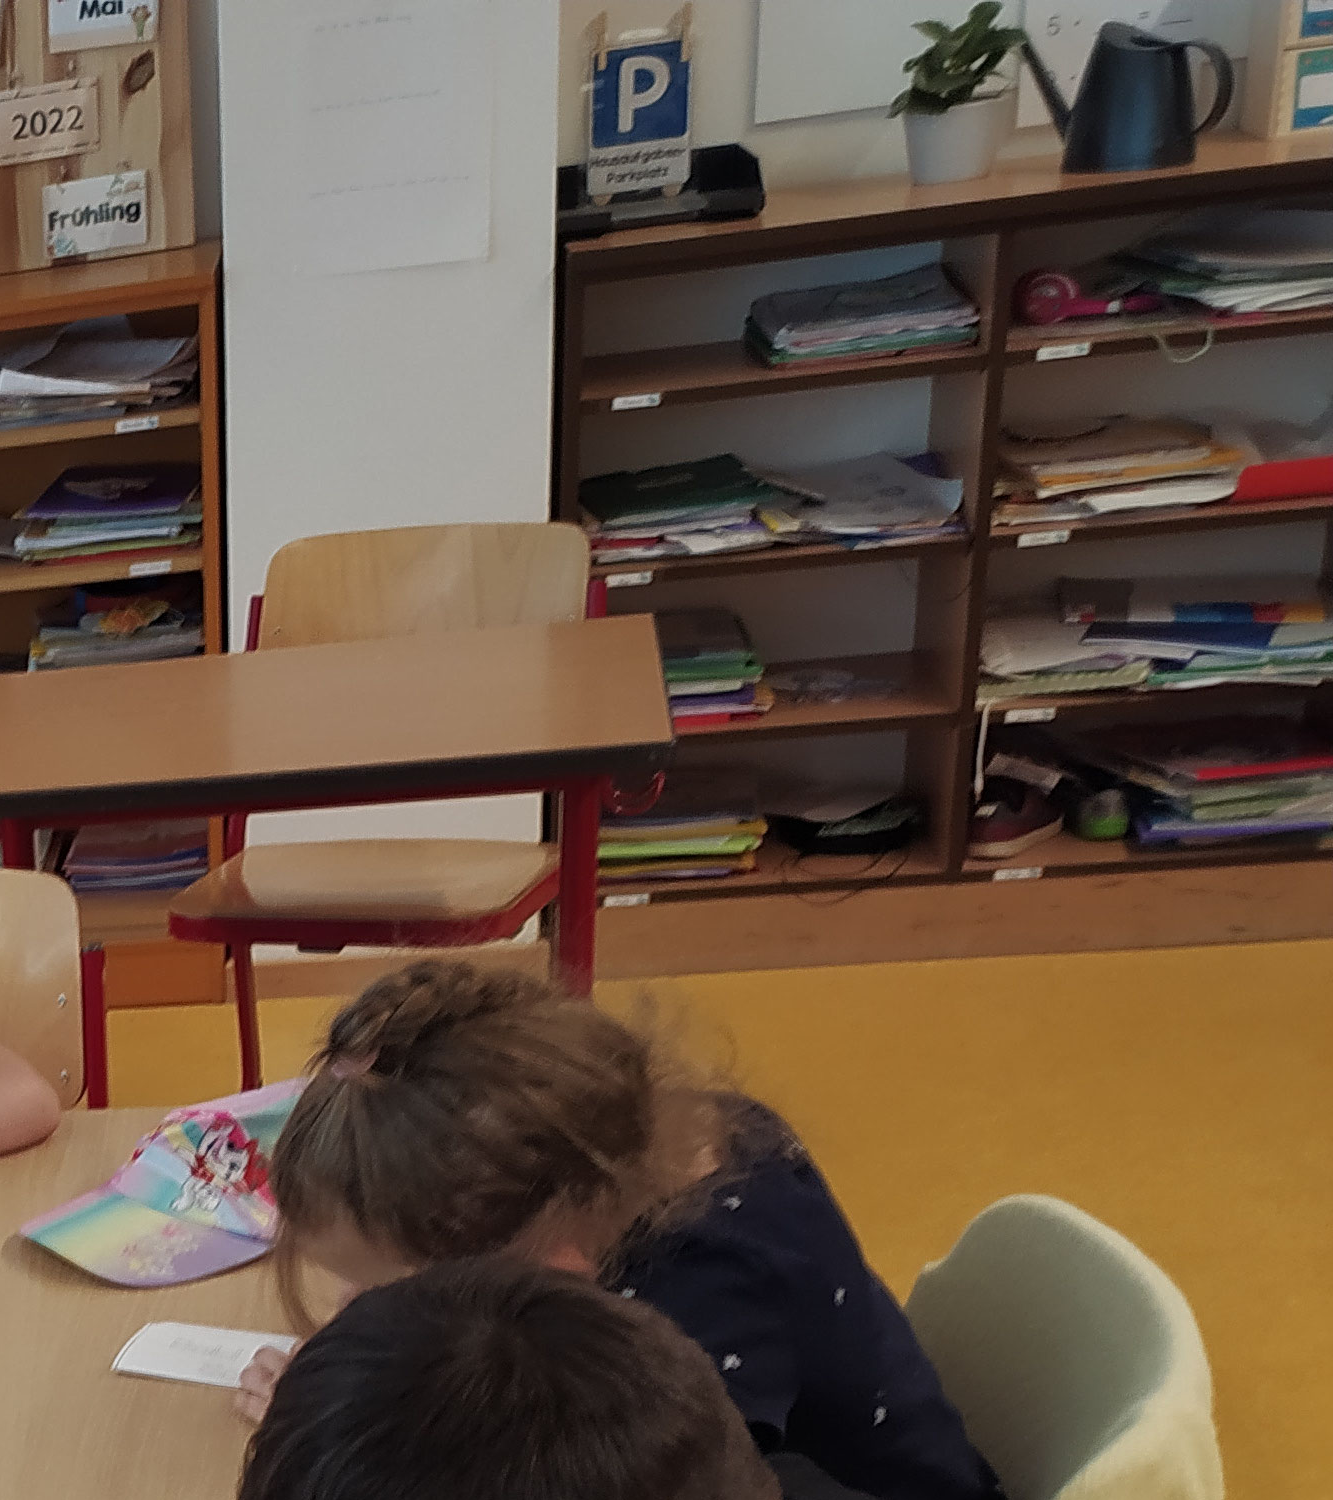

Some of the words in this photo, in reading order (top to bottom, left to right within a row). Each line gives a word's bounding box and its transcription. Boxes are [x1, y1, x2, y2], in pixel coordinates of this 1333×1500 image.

[79, 0, 123, 21] Mai
[618, 55, 671, 133] P
[13, 105, 83, 141] 2022
[48, 201, 141, 232] Frühling
